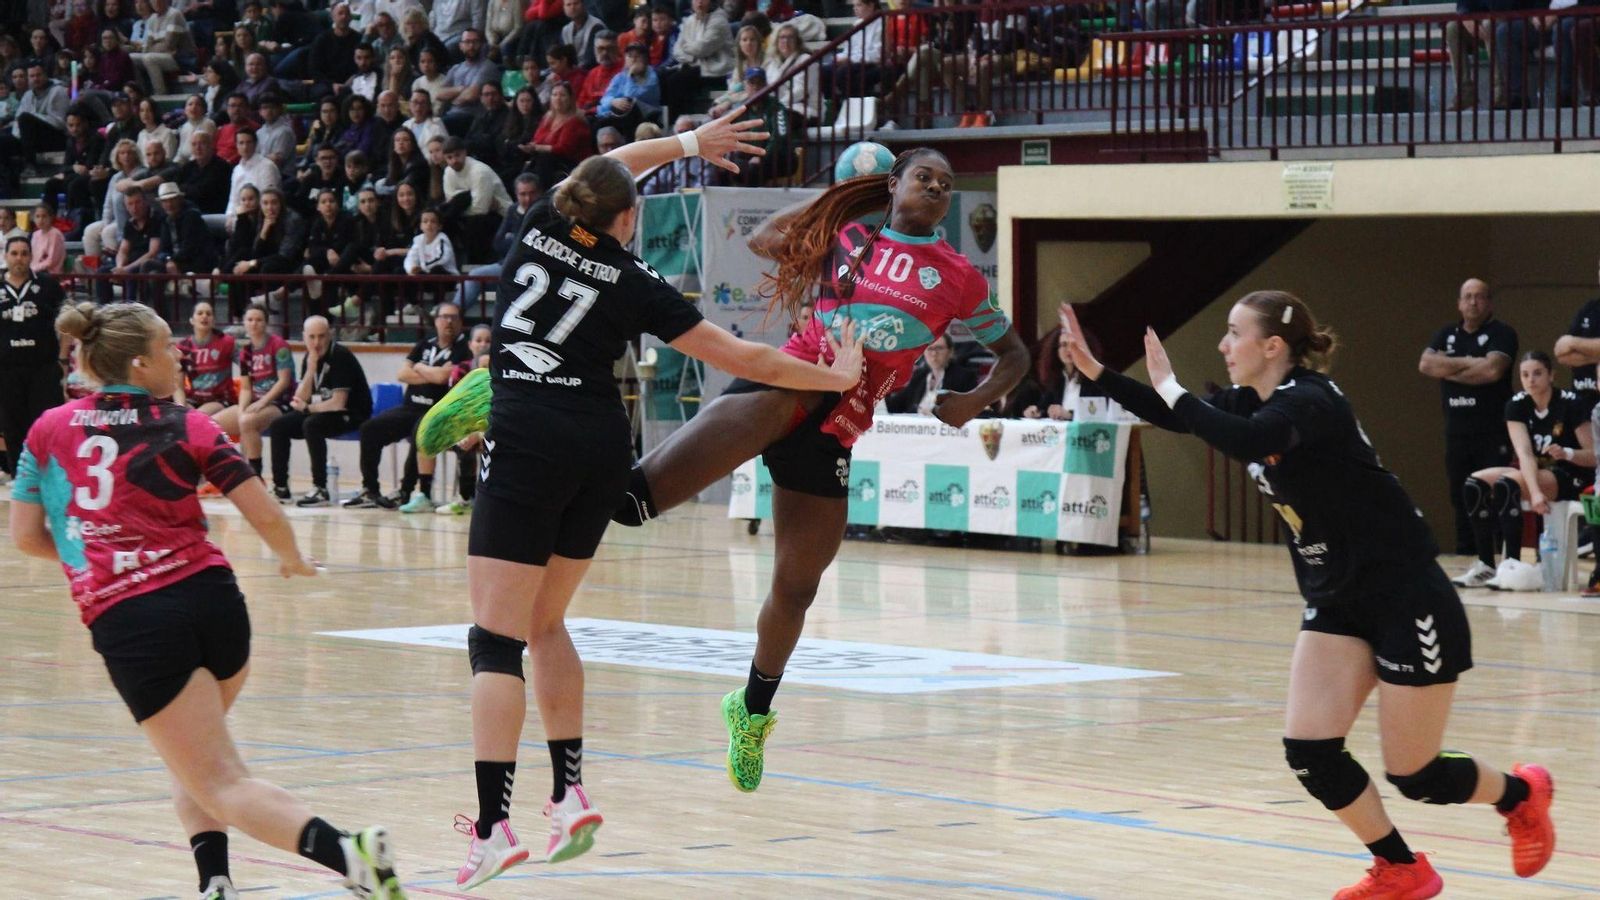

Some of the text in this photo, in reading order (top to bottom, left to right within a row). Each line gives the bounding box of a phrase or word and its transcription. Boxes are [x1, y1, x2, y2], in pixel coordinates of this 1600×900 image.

[874, 247, 914, 283] 10
[501, 262, 600, 345] 27
[877, 421, 937, 436] Balonmano
[75, 434, 120, 510] 3
